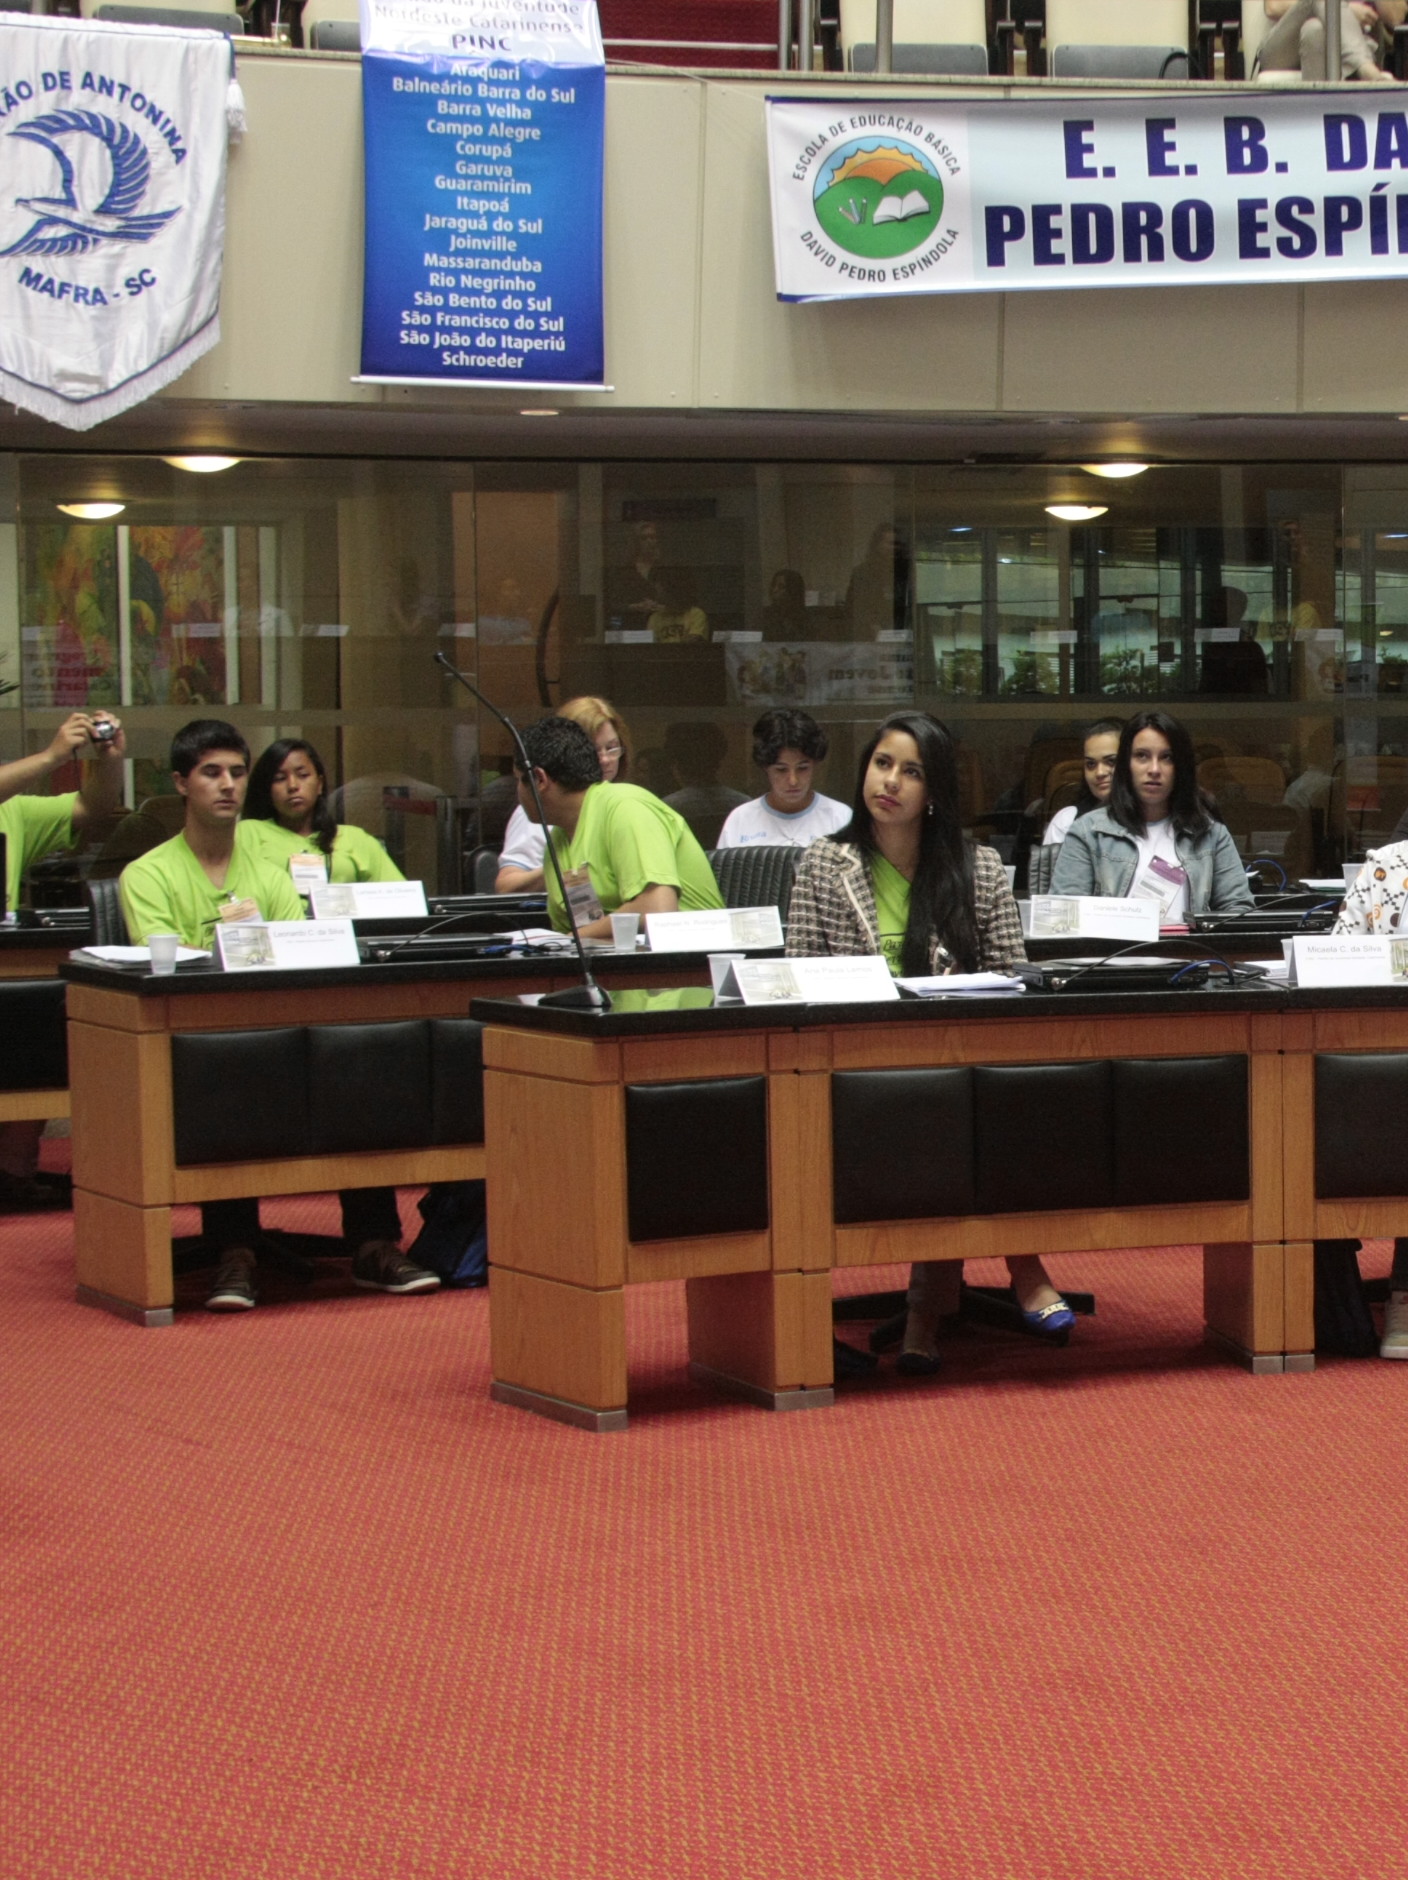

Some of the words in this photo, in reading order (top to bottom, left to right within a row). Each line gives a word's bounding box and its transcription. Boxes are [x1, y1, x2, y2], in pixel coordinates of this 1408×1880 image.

[451, 63, 520, 82] Araquari
[393, 77, 472, 96] Balneário
[478, 83, 521, 100] Barra
[526, 85, 546, 102] do
[551, 87, 575, 104] Sul
[0, 80, 33, 117] ÃO
[41, 71, 72, 92] DE
[81, 71, 187, 166] ANTONINA
[437, 100, 481, 117] Barra
[486, 102, 532, 120] Velha
[427, 119, 484, 139] Campo
[488, 122, 541, 142] Alegre
[456, 140, 512, 160] Corupá
[792, 133, 829, 181] ESCOLA
[829, 121, 848, 138] DE
[850, 113, 924, 138] EDUCAÇÃO
[924, 130, 961, 176] BÁSICA
[1063, 119, 1116, 180] E.
[1144, 116, 1199, 178] E.
[1222, 114, 1289, 175] B.
[455, 160, 513, 178] Garuva
[434, 175, 532, 195] Guaramirim
[457, 196, 509, 215] Itapoá
[424, 213, 488, 233] Jaraguá
[493, 215, 513, 232] do
[518, 218, 543, 234] Sul
[983, 198, 1216, 268] PEDRO
[449, 234, 517, 252] Joinville
[424, 253, 542, 273] Massaranduba
[800, 230, 837, 268] DAVID
[838, 262, 886, 283] PEDRO
[892, 228, 959, 282] ESPÍNDOLA
[18, 266, 108, 306] MAFRA
[124, 268, 157, 297] SC
[429, 272, 455, 288] Rio
[461, 274, 536, 293] Negrinho
[414, 291, 444, 306] São
[449, 293, 497, 309] Bento
[502, 295, 522, 310] do
[527, 297, 552, 312] Sul
[401, 310, 431, 325] São
[436, 312, 510, 329] Francisco
[514, 314, 535, 330] do
[539, 316, 564, 332] Sul
[400, 330, 430, 345] São
[433, 331, 471, 349] João
[475, 332, 496, 348] do
[501, 335, 566, 353] Itaperiú
[442, 351, 524, 368] Schroeder
